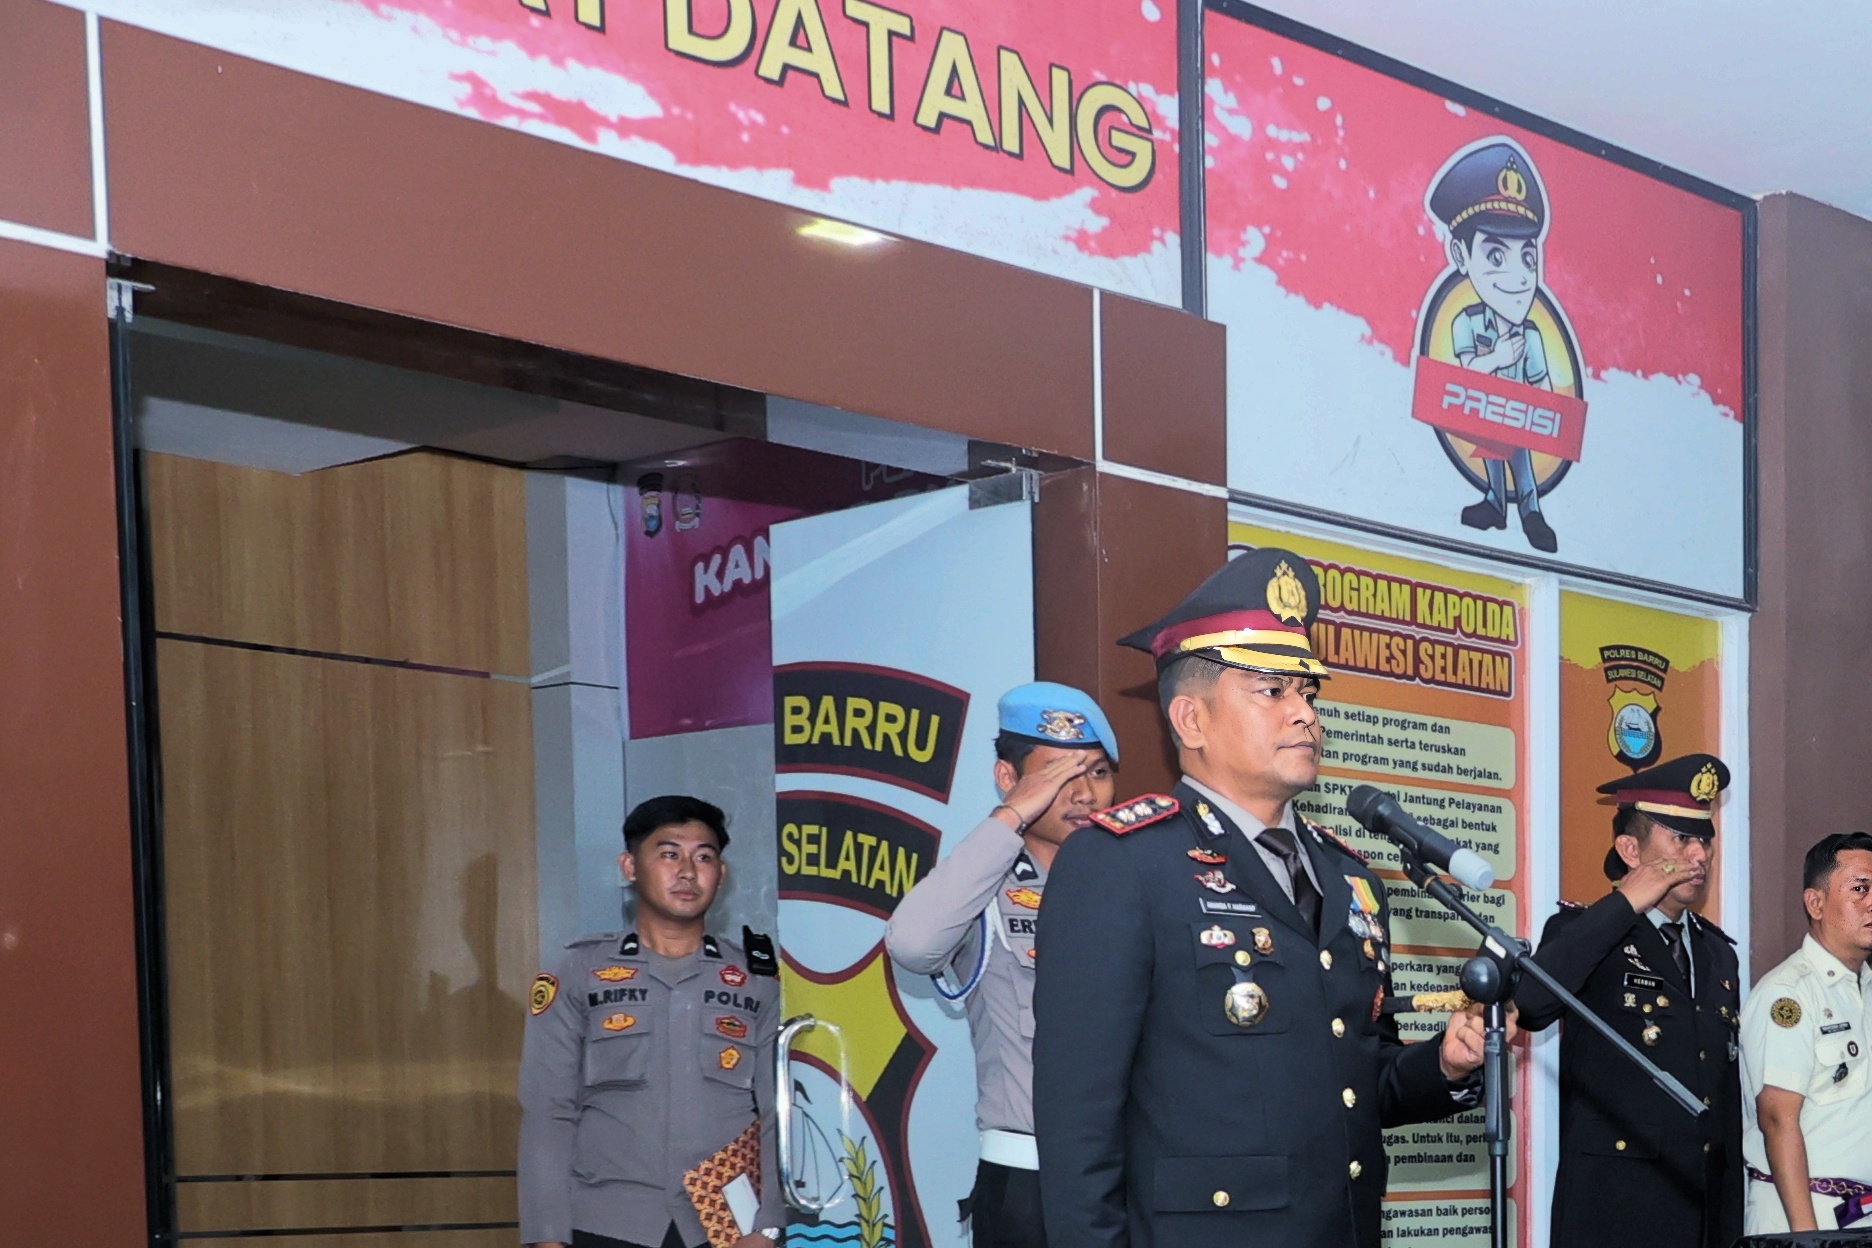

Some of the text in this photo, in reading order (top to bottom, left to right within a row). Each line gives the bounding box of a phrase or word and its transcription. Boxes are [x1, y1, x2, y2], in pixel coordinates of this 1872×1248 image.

[662, 0, 1156, 192] DATANG
[1441, 382, 1561, 438] PRESISI
[1416, 586, 1515, 642] KAPOLDA
[1418, 640, 1509, 693] SELATAN
[1603, 649, 1666, 669] POLRES BARRU
[783, 695, 940, 763] BARRU
[1344, 710, 1379, 726] setiap
[1382, 716, 1428, 735] program
[1430, 717, 1451, 735] dan
[1387, 737, 1416, 751] serta
[1418, 740, 1466, 756] teruskan
[1342, 751, 1389, 769] program
[1392, 758, 1419, 772] yang
[1420, 760, 1454, 775] sudah
[1456, 765, 1503, 782] berjalan.
[1403, 792, 1446, 809] Jantung
[1448, 797, 1502, 814] Pelayanan
[1461, 818, 1497, 833] bentuk
[1475, 842, 1500, 855] yang
[780, 822, 918, 898] SELATAN
[1483, 893, 1505, 908] bagi
[1391, 961, 1461, 976] perkara yang
[704, 990, 761, 1013] POLRI
[1412, 1132, 1444, 1144] Untuk
[1394, 1152, 1454, 1166] pembinaan
[1456, 1152, 1476, 1163] dan
[1436, 1205, 1459, 1217] baik
[1461, 1206, 1491, 1218] perso
[1396, 1226, 1440, 1238] lakukan
